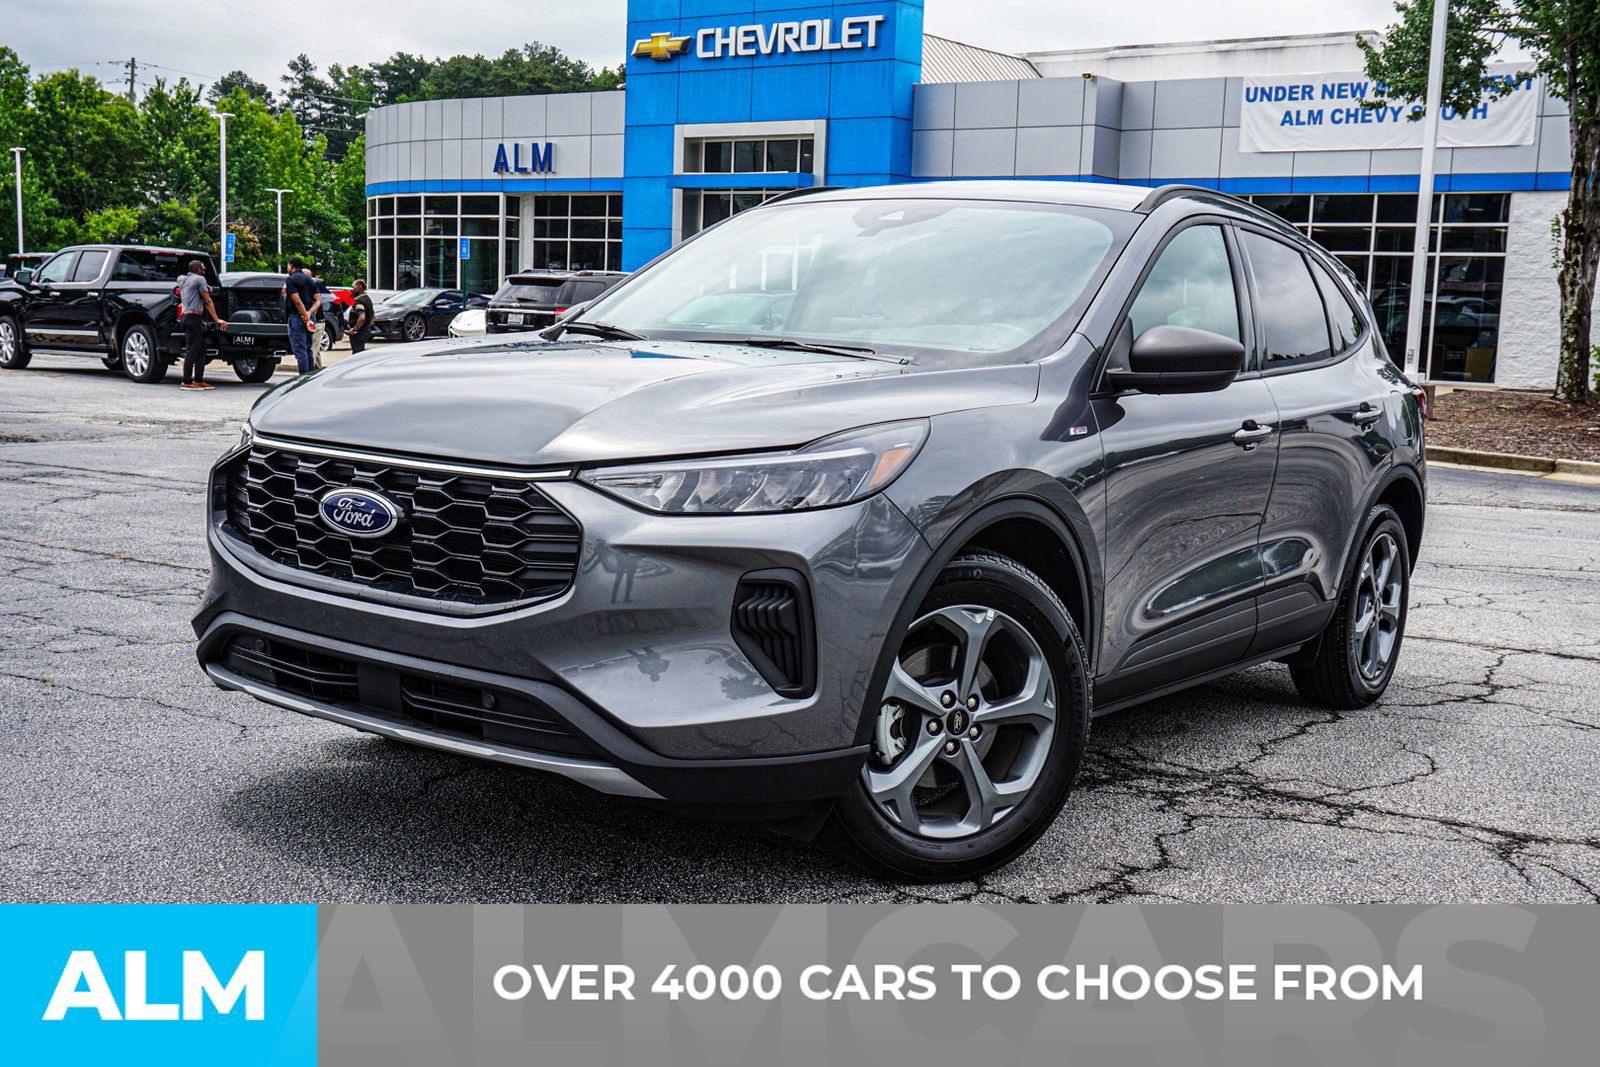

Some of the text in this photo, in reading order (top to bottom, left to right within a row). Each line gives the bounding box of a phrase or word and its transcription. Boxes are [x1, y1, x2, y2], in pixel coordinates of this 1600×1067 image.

[696, 14, 886, 59] CHEVROLET
[1245, 84, 1314, 103] UNDER
[1320, 81, 1369, 101] NEW
[1280, 102, 1488, 127] ALM CHEVY SUH
[493, 142, 556, 174] ALM
[333, 497, 376, 527] Ford
